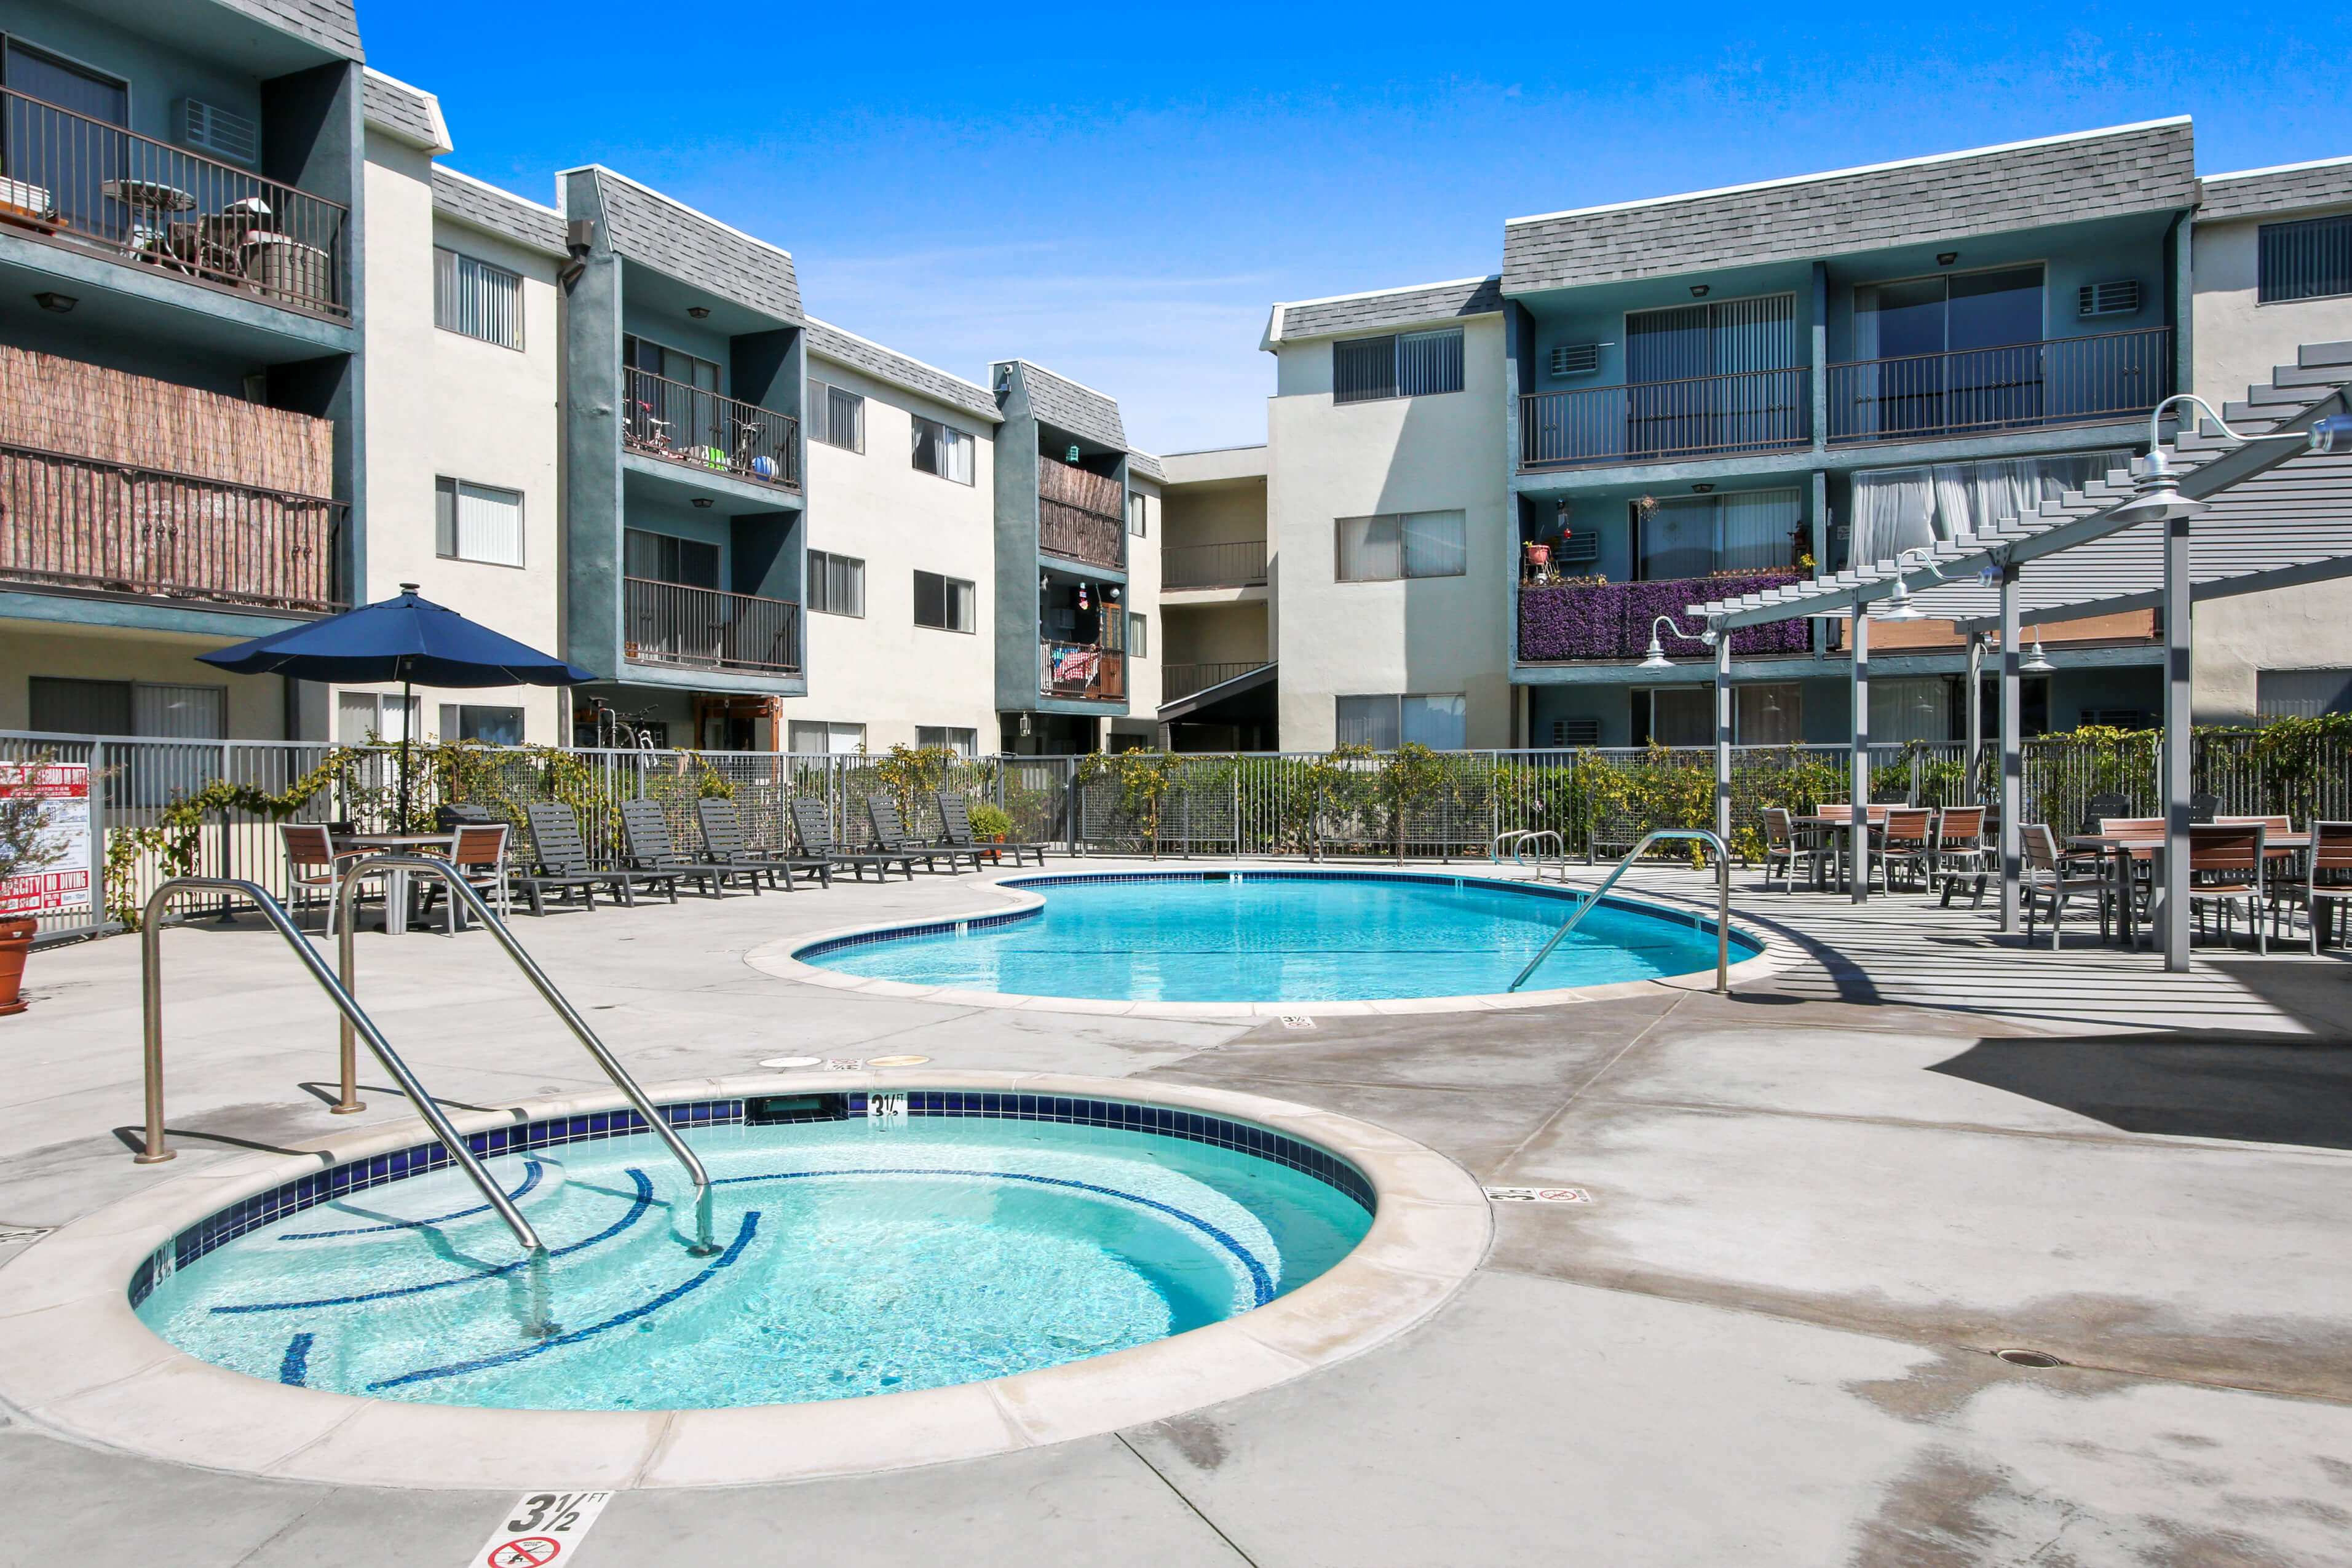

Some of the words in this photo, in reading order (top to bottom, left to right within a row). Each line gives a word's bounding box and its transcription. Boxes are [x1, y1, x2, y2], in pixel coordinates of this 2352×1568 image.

[0, 876, 40, 896] APACITY
[47, 874, 57, 891] NO
[60, 871, 86, 890] DIVING
[588, 1493, 608, 1502] FT
